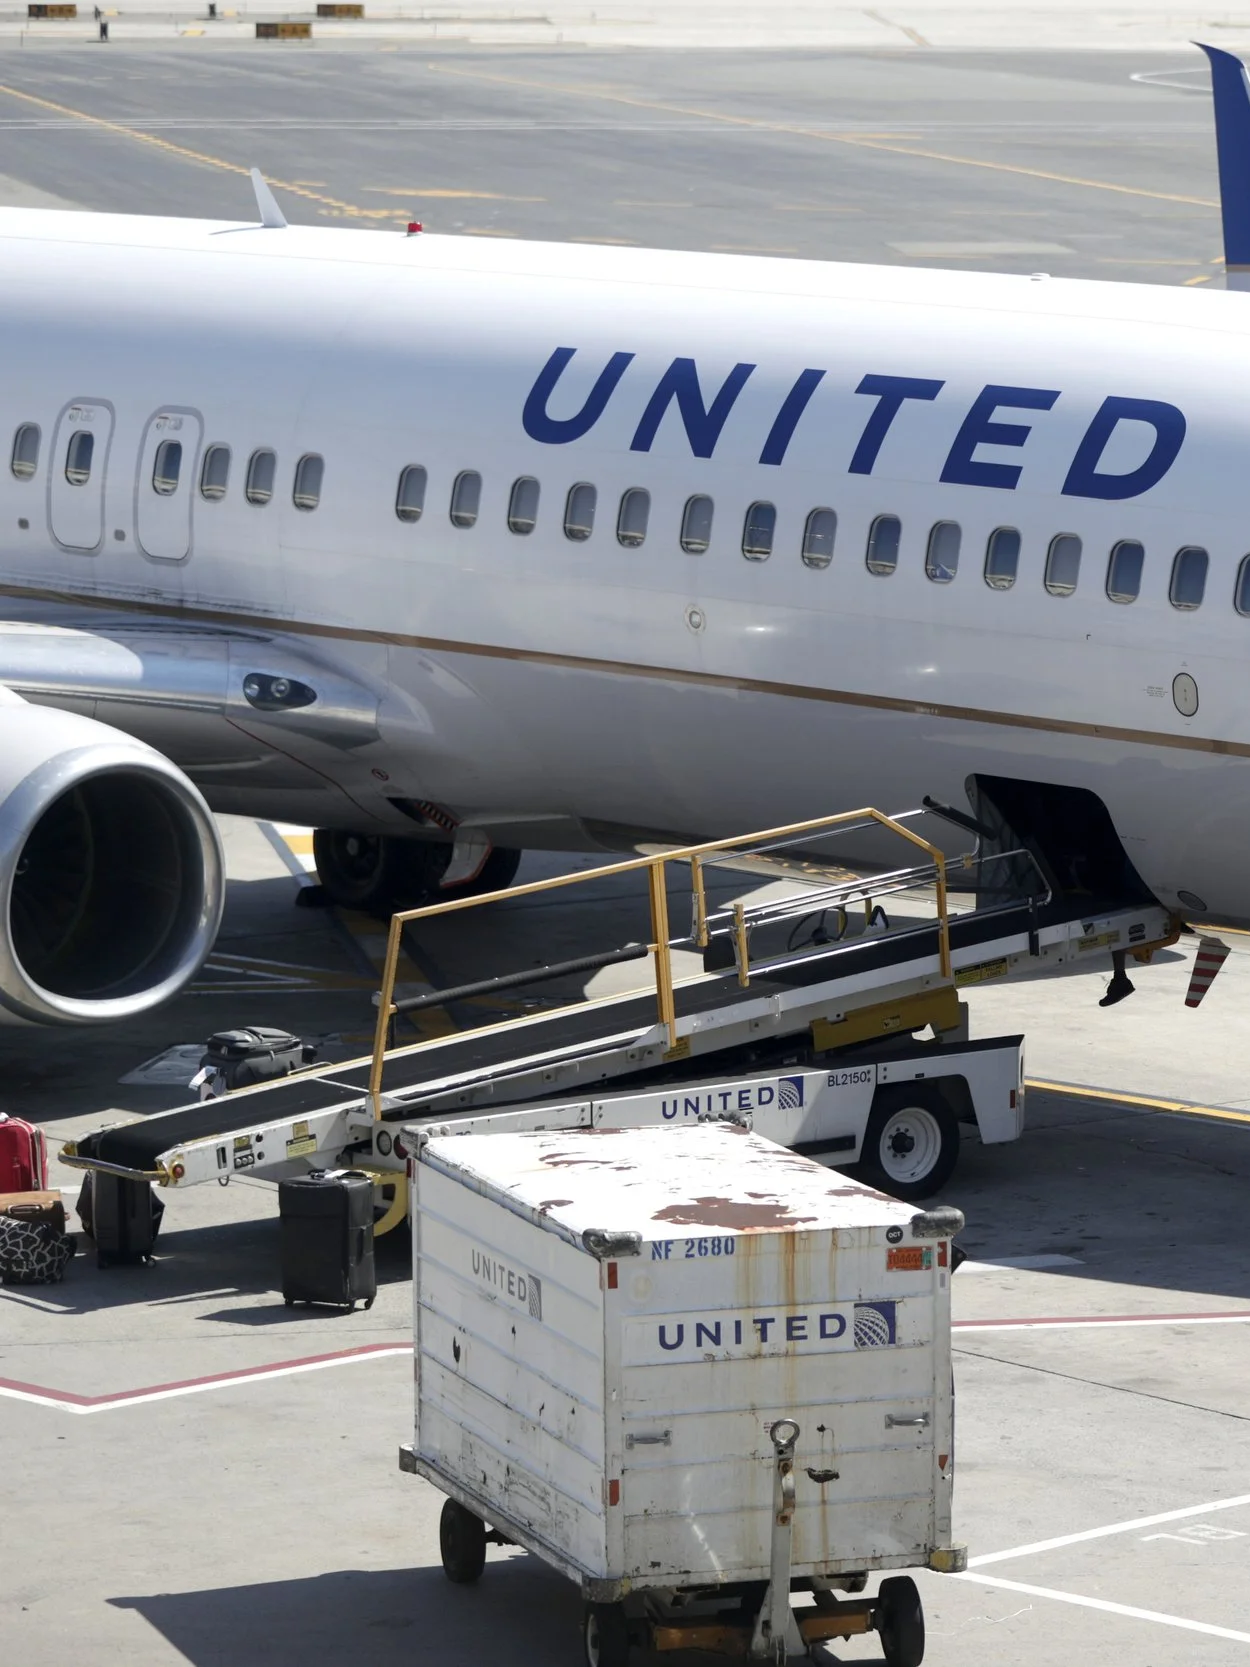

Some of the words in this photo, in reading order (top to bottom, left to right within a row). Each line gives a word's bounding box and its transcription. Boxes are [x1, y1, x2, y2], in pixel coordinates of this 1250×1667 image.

[521, 346, 1188, 502] UNITED
[662, 1086, 775, 1120] UNITED
[651, 1240, 675, 1261] NF
[684, 1236, 735, 1259] 2680
[472, 1249, 526, 1302] UNITED
[658, 1313, 847, 1350] UNITED
